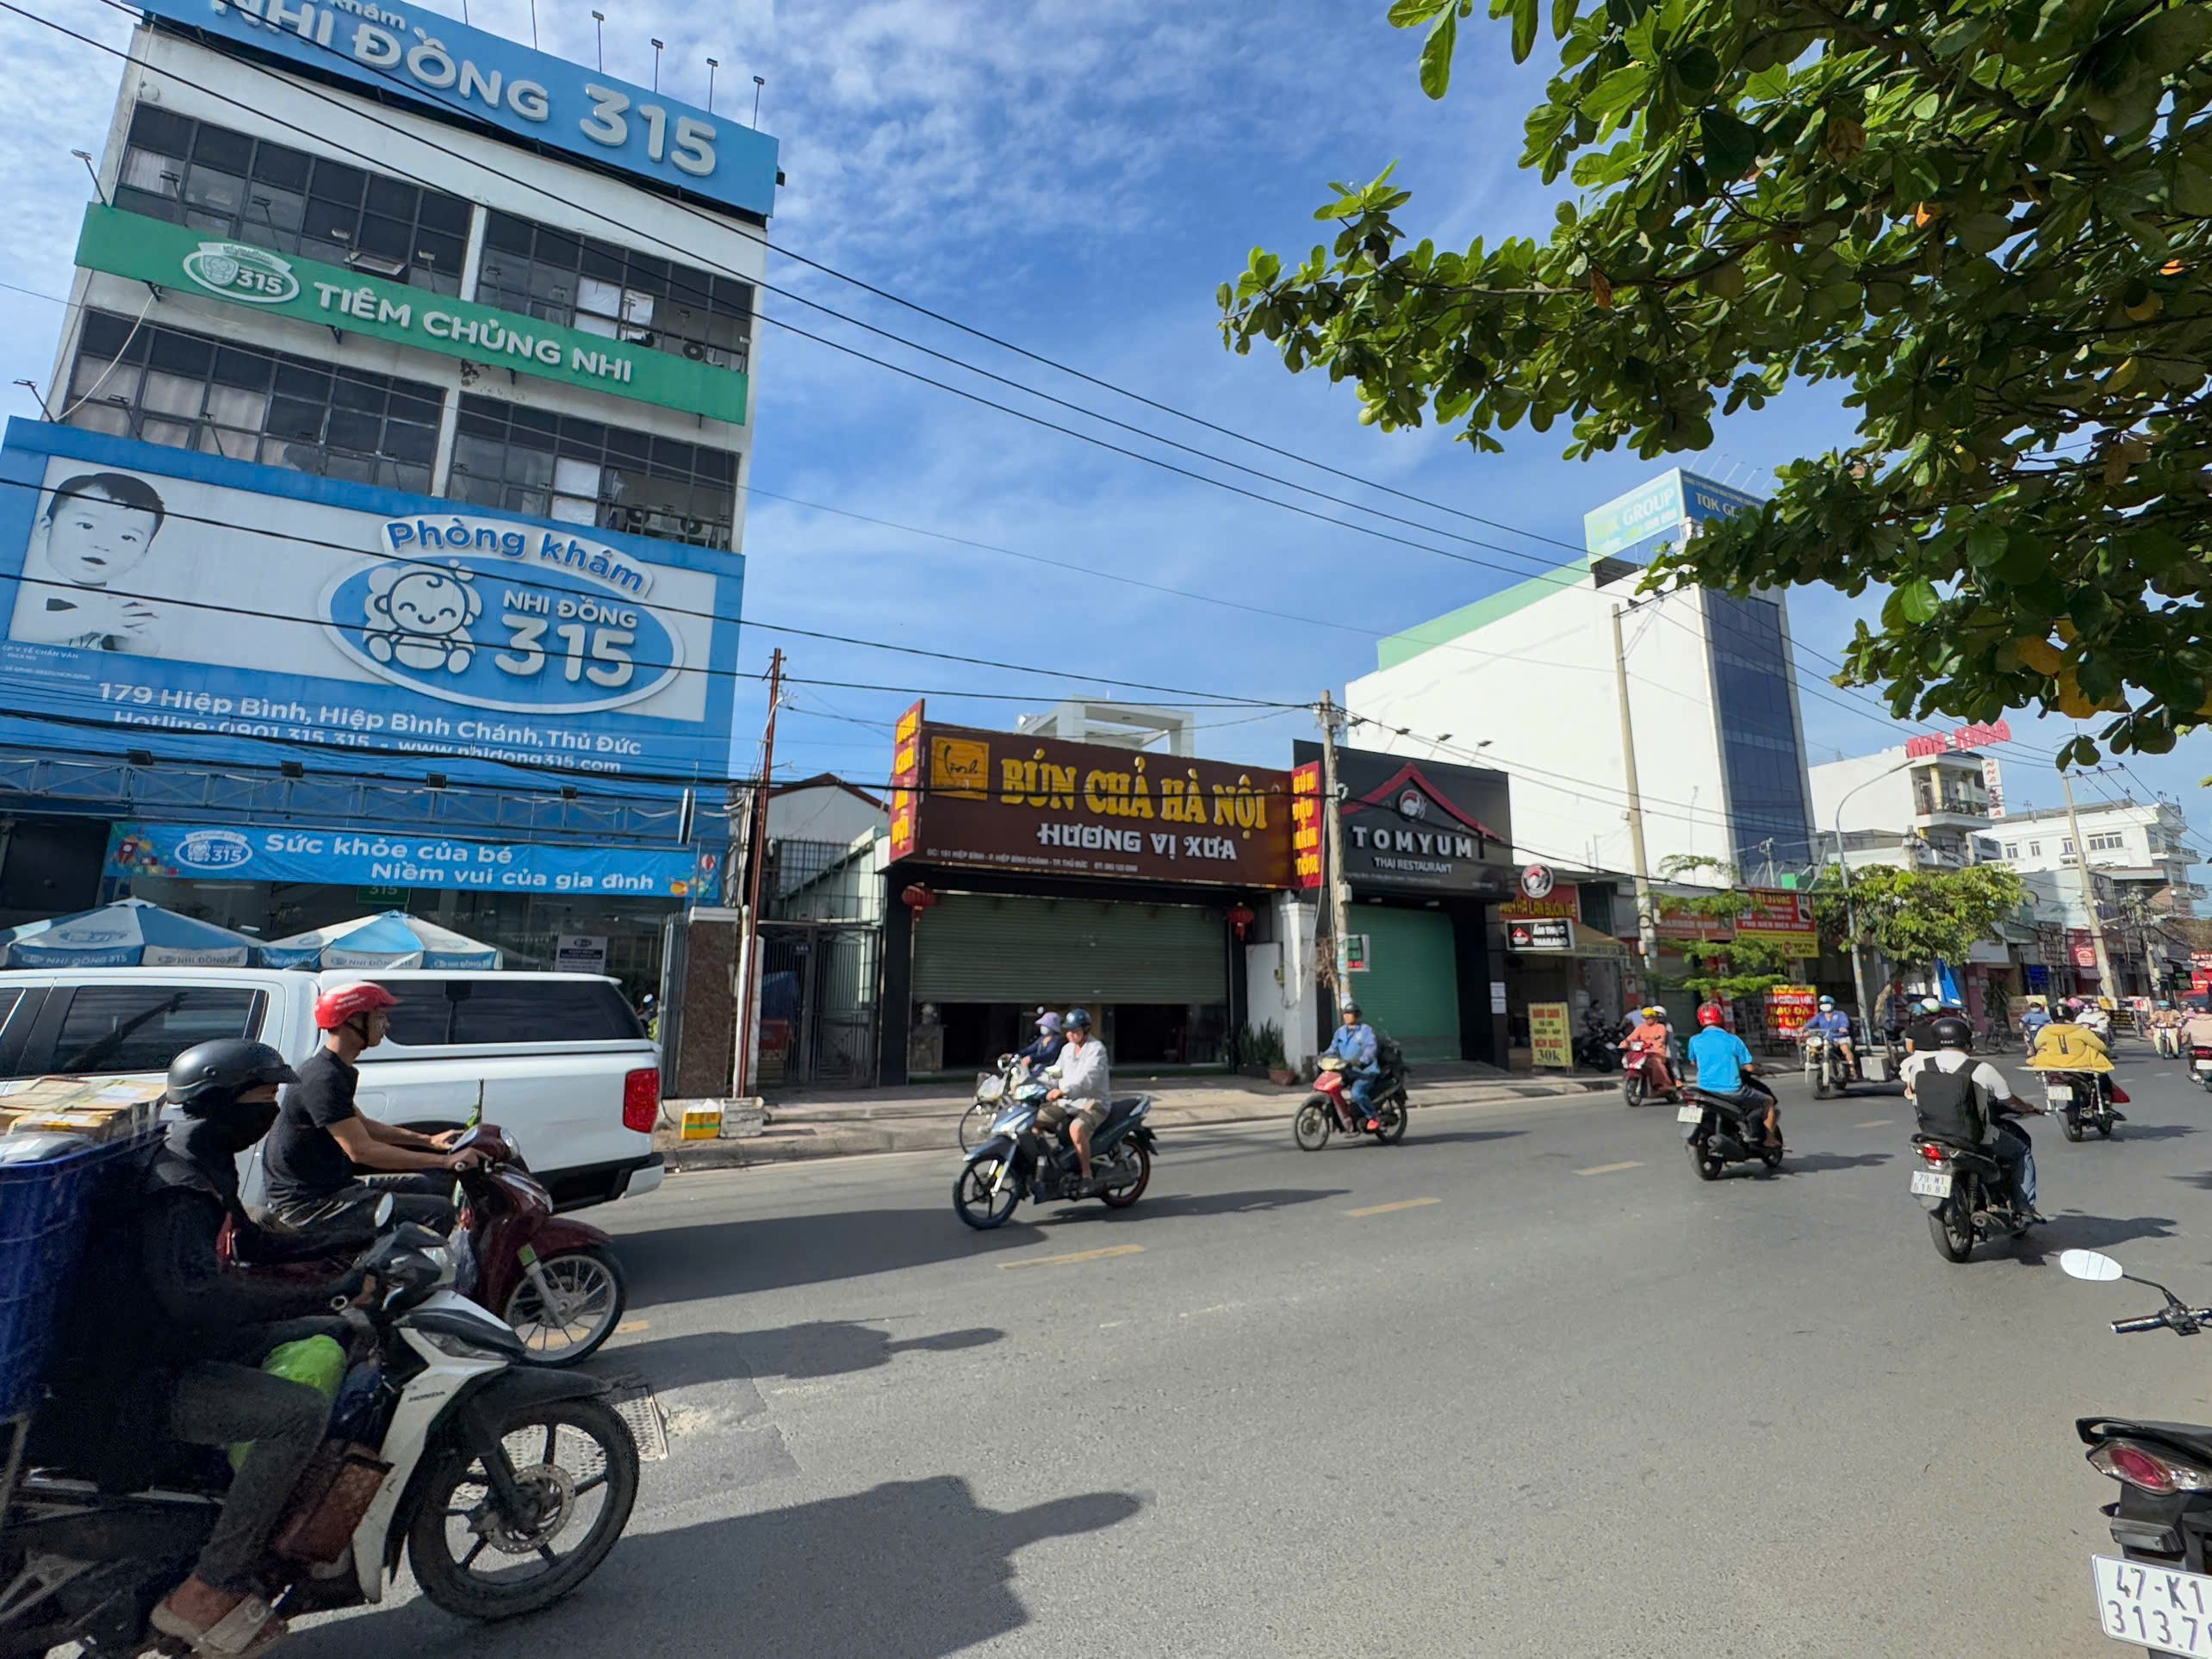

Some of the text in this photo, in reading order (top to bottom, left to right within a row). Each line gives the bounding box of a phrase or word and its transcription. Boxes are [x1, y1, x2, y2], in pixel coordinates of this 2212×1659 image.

[352, 27, 549, 121] ĐỒNG
[579, 84, 717, 177] 315
[237, 268, 283, 295] 315
[314, 282, 632, 383] TIÊM CHỦNG NHI
[1623, 488, 1675, 526] GROUP
[387, 518, 644, 593] Phòng khám
[503, 589, 637, 628] NHI ĐỒNG
[494, 614, 635, 687] 315
[99, 682, 642, 755] 179 Hiệp Bình, Hiệp Bình Chánh, Thủ Đức
[1001, 748, 1076, 811] BÚN
[1084, 755, 1154, 819] CHẢ
[1160, 767, 1208, 823] HÀ
[1212, 774, 1267, 840] NỘI
[211, 849, 241, 861] 315
[265, 833, 513, 864] Sức khỏe của bé
[1037, 822, 1238, 861] HƯƠNG VỊ XƯA
[1352, 825, 1473, 859] TOMYUM
[371, 861, 654, 891] Niềm vui của gia đình
[1375, 856, 1454, 873] THAI RESTAURANT
[2116, 1565, 2205, 1614] 47-K1
[2107, 1600, 2212, 1652] 313.7
